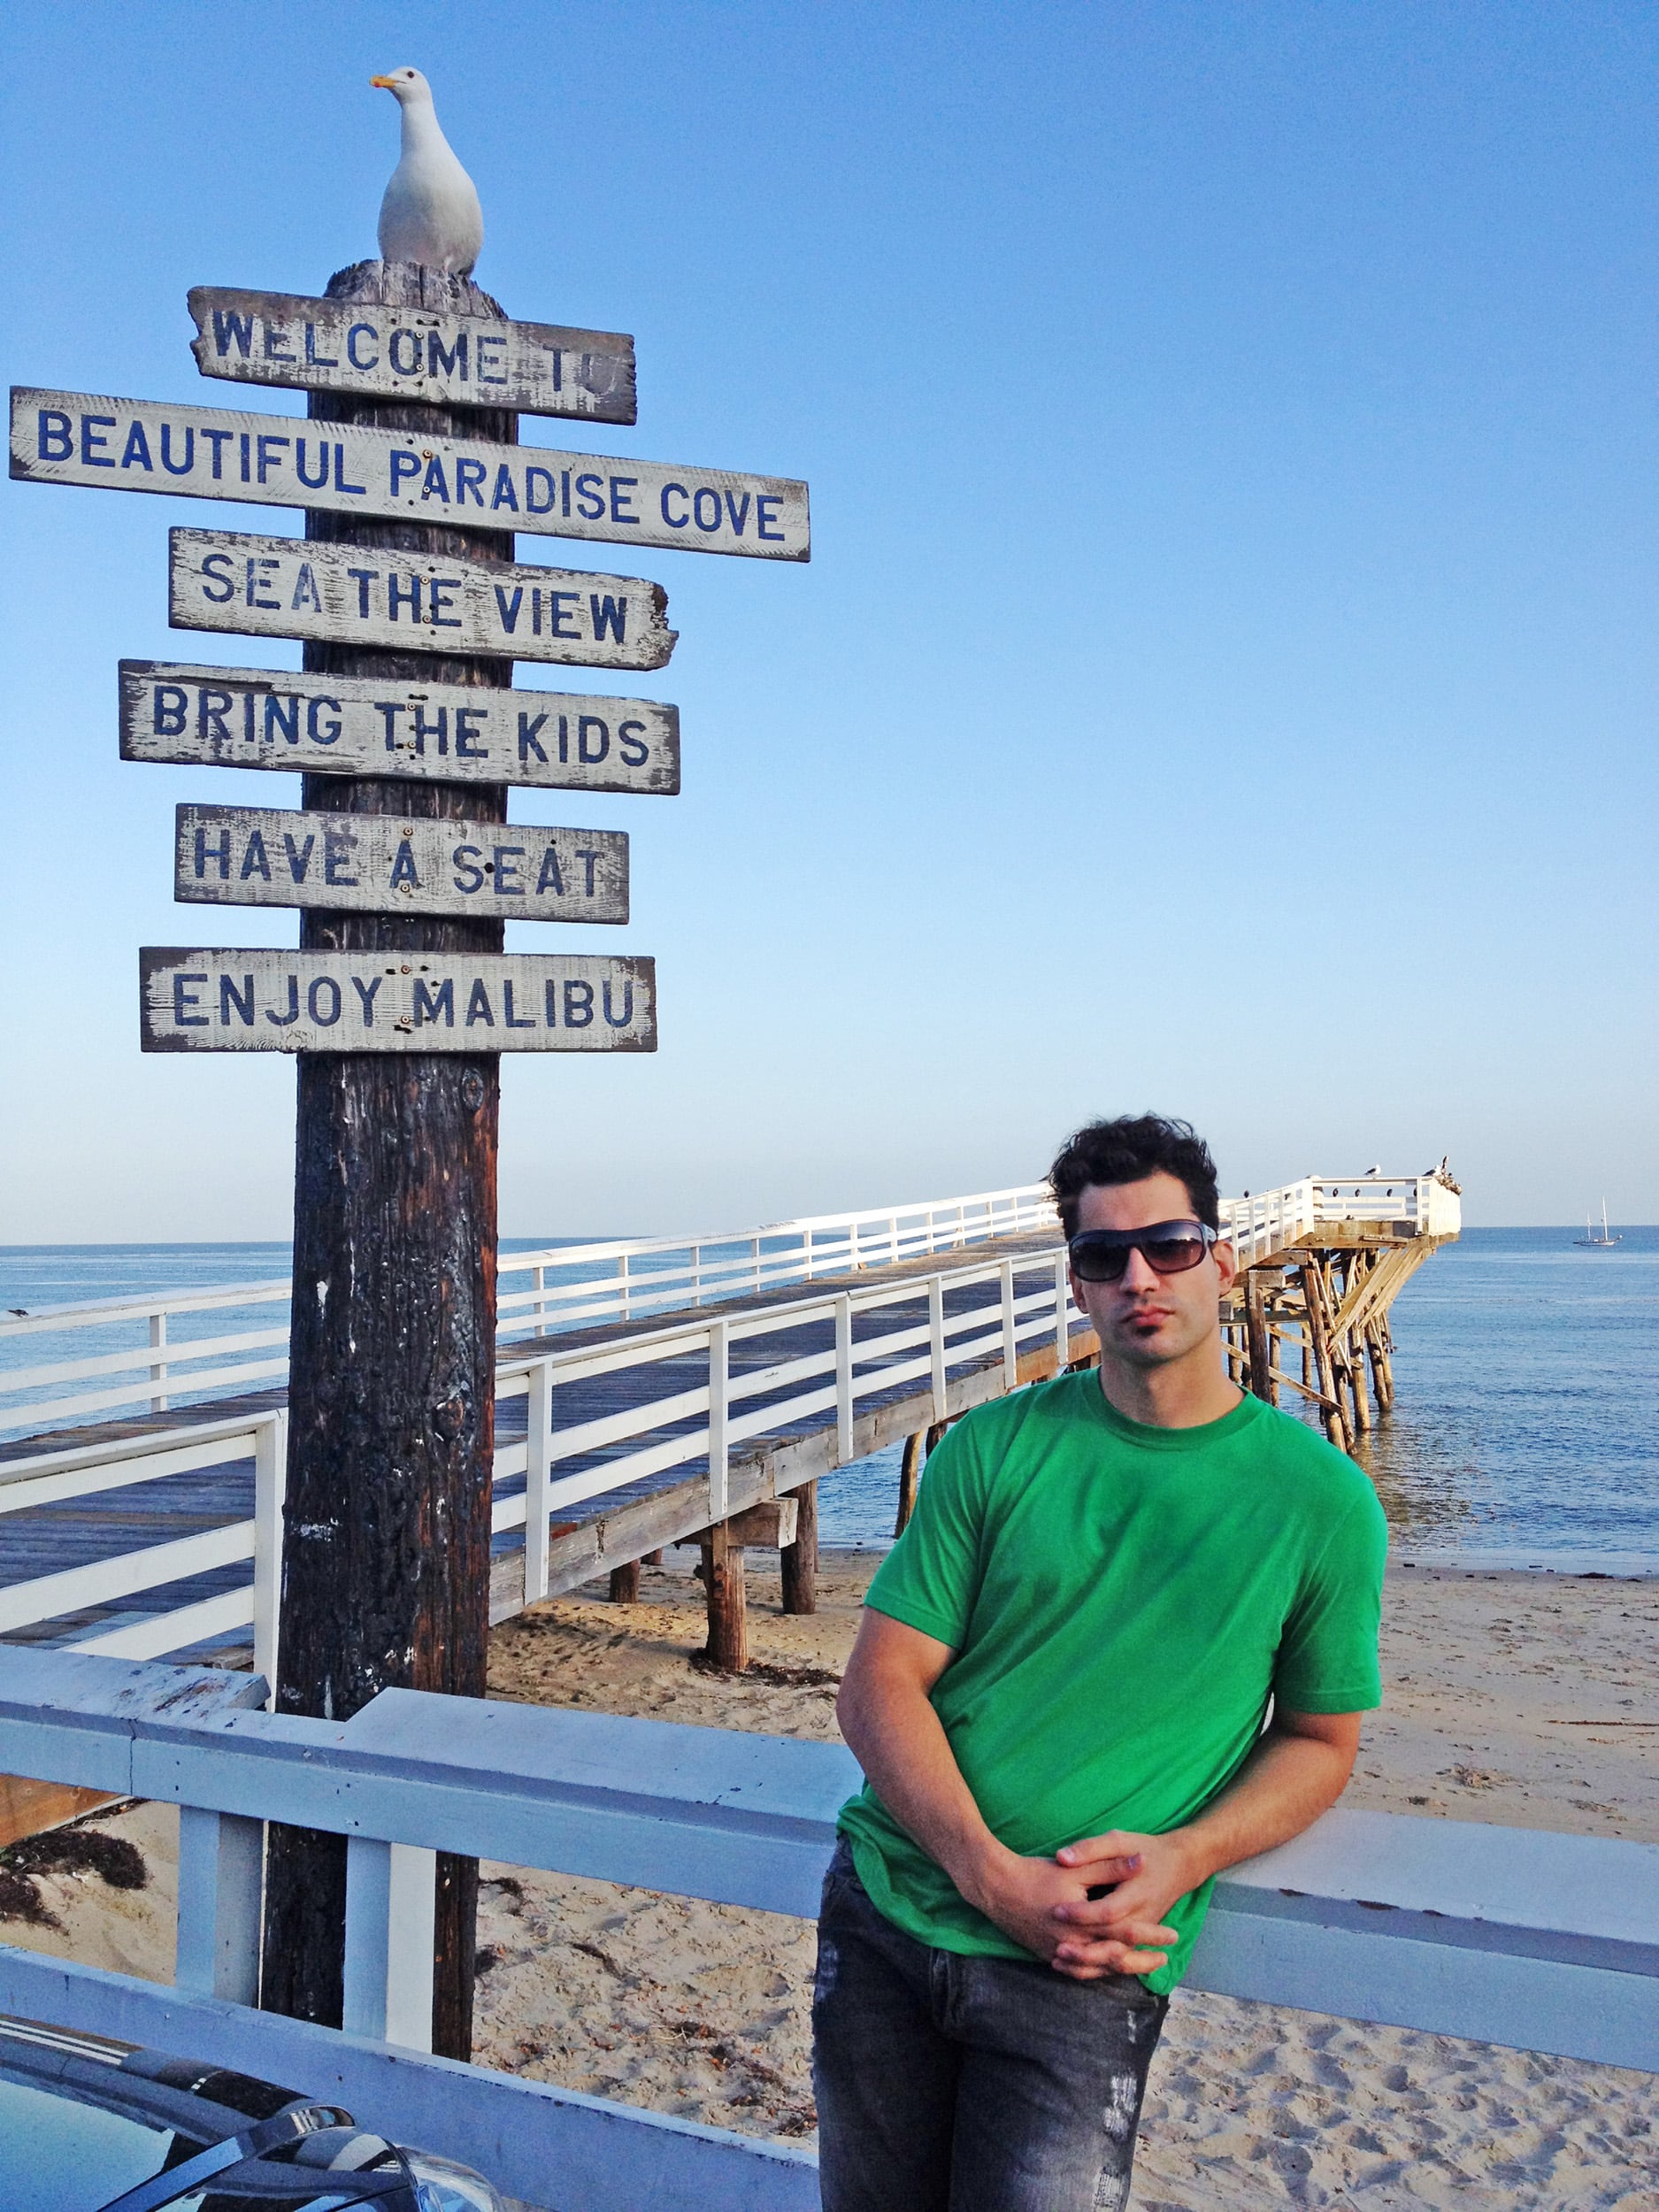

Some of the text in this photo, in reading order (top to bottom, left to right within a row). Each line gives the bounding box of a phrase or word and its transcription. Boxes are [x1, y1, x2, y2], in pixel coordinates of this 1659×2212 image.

[212, 309, 510, 385] WELCOME
[37, 409, 786, 542] BEAUTIFUL PARADISE COVE
[201, 553, 628, 645] SEA THE VIEW
[152, 685, 650, 767] BRING THE KIDS
[193, 827, 604, 898] HAVE A SEAT
[173, 972, 634, 1028] ENJOY MALIBU
